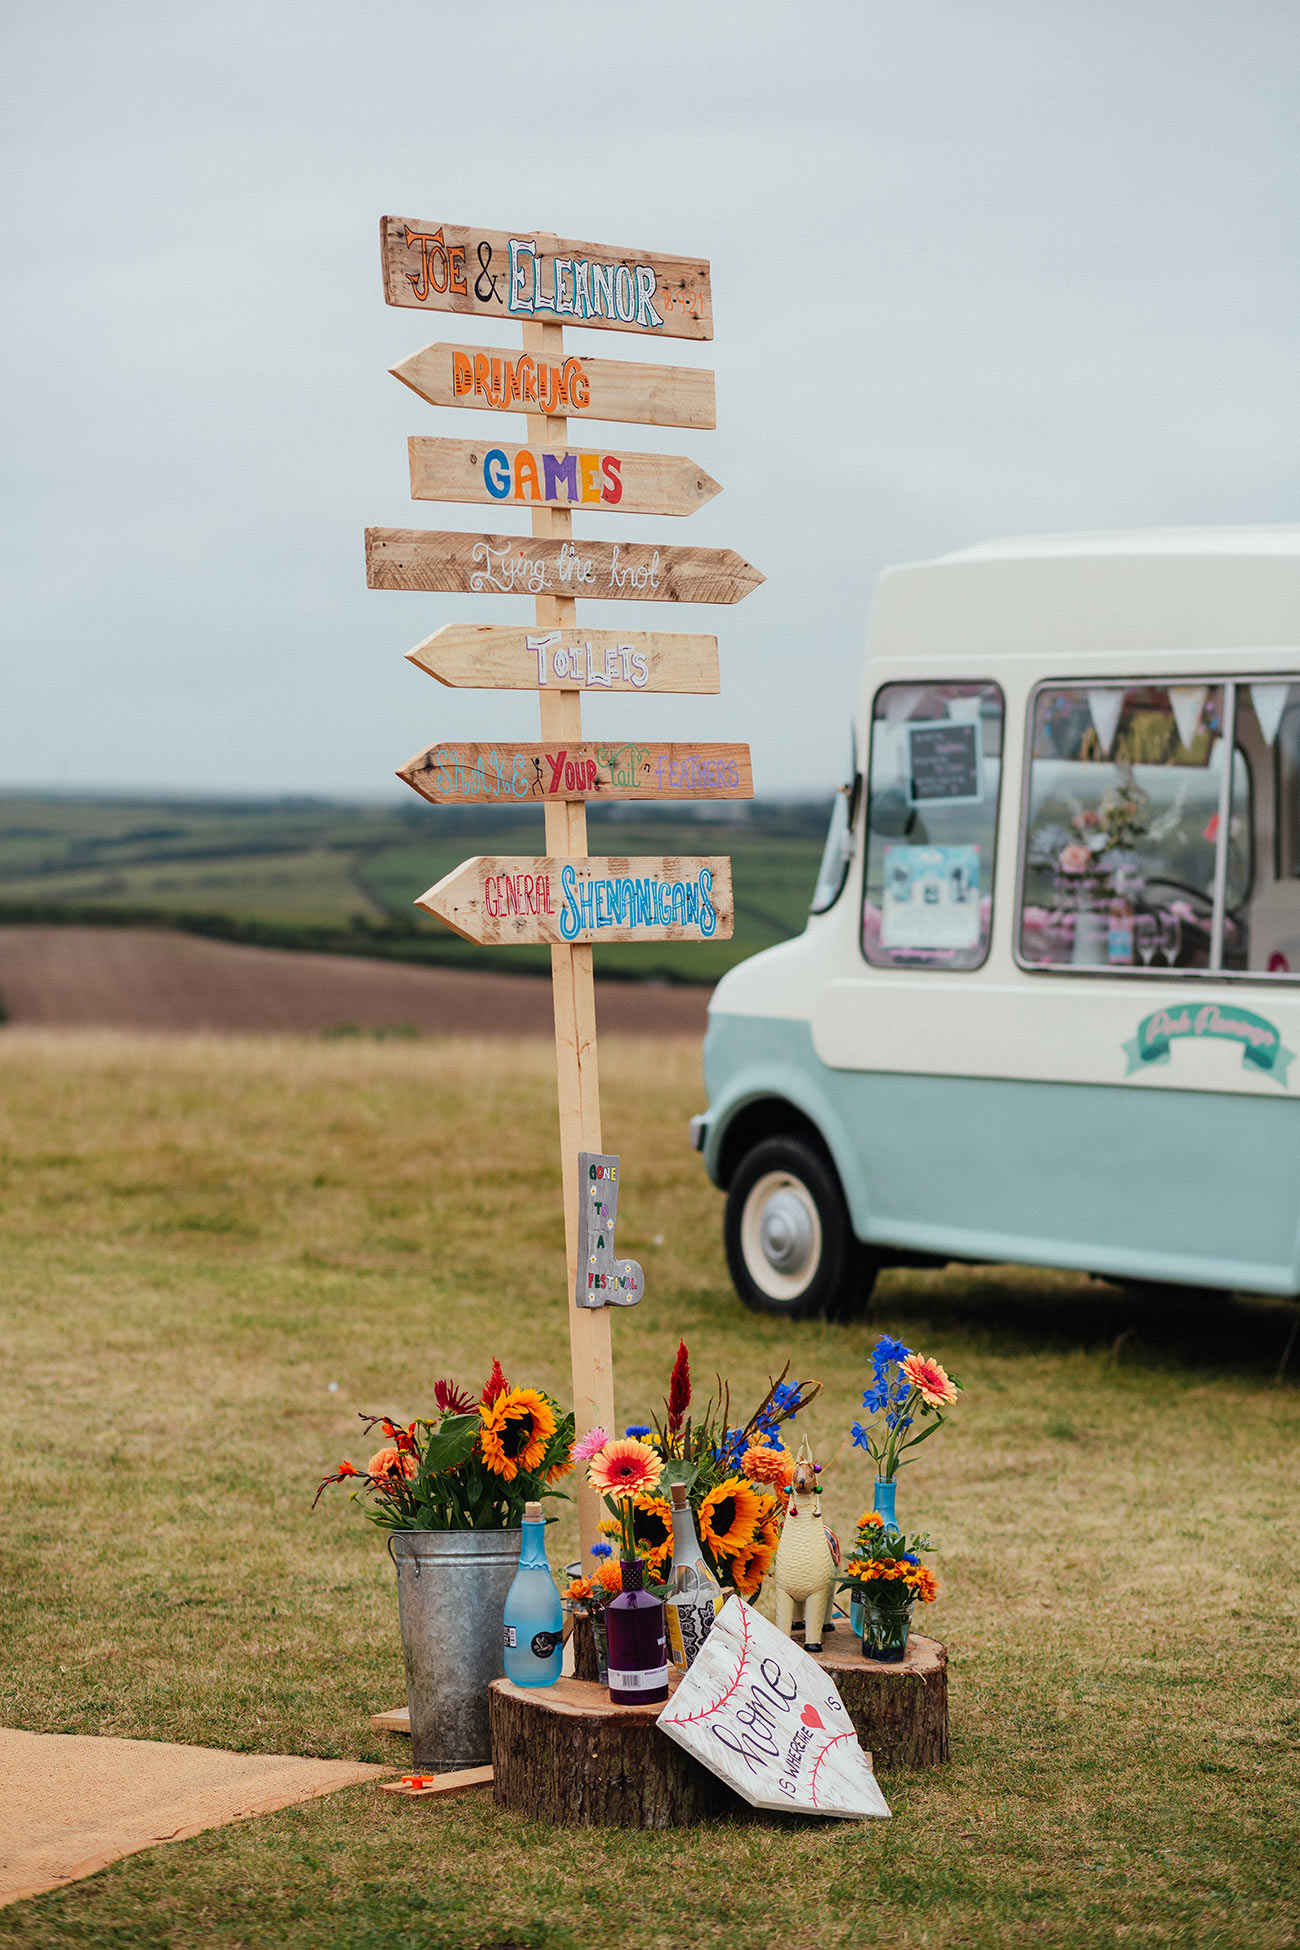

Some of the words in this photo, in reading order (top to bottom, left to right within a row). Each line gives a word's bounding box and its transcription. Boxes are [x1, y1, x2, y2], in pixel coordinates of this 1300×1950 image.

[404, 224, 468, 302] JOE
[474, 241, 503, 304] &
[508, 238, 664, 328] ELEANOR
[452, 350, 591, 414] DRINKING
[483, 448, 623, 505] GAMES
[470, 540, 552, 593] Tying
[556, 541, 597, 583] the
[608, 545, 660, 588] knot
[526, 630, 649, 689] TOILETS
[436, 750, 529, 797] SHAKE
[544, 750, 599, 793] YOUR
[655, 754, 740, 790] FEATHERS
[484, 874, 556, 918] GENERAL
[560, 864, 716, 940] SHENANIGANS
[589, 1164, 617, 1181] GONE
[594, 1202, 609, 1217] TO
[596, 1234, 605, 1249] A
[588, 1272, 638, 1290] FESTIVAL
[711, 1658, 798, 1775] home
[824, 1696, 842, 1711] IS
[783, 1737, 806, 1778] WHERE
[778, 1778, 796, 1799] IS
